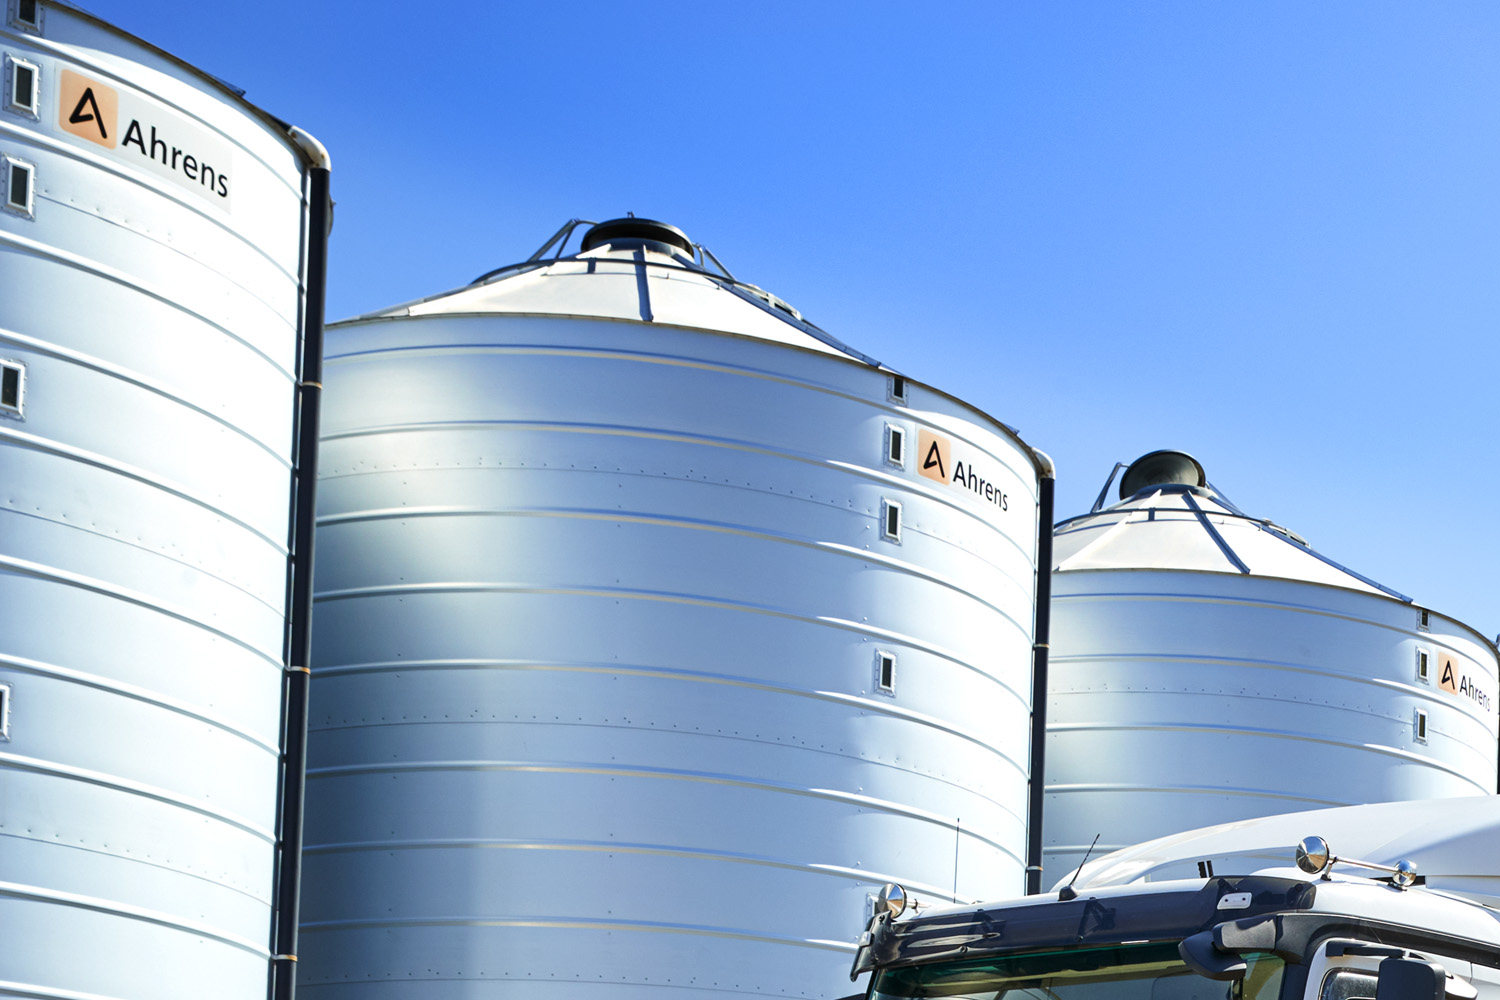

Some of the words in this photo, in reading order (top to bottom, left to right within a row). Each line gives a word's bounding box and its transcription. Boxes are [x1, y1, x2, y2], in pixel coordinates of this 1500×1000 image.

[121, 118, 229, 198] Ahrens
[953, 461, 1008, 512] Ahrens
[1459, 675, 1491, 712] Ahrens
